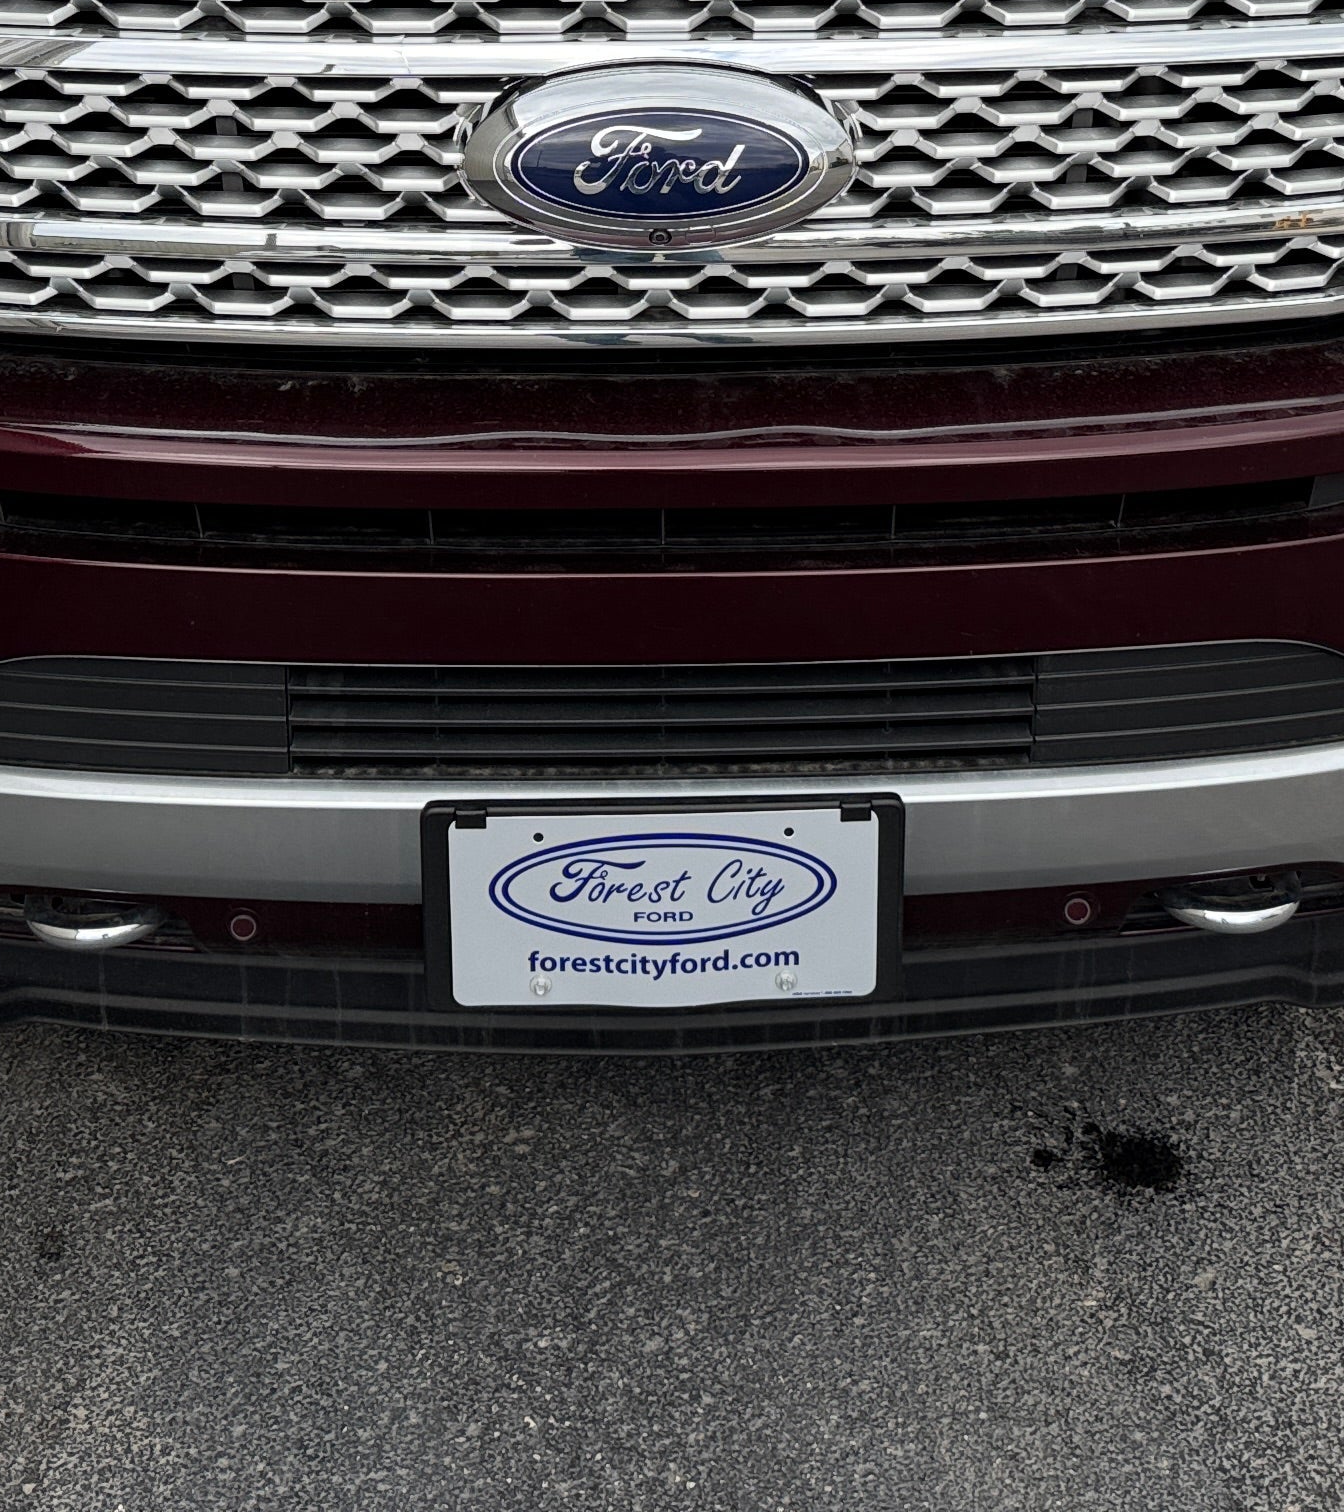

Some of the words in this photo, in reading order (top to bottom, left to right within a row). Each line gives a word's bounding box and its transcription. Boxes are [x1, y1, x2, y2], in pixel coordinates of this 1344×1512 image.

[573, 125, 746, 195] Ford
[549, 858, 692, 904] Forest
[706, 859, 785, 916] City
[633, 910, 694, 923] FORD
[528, 948, 801, 980] forestcityford.com
